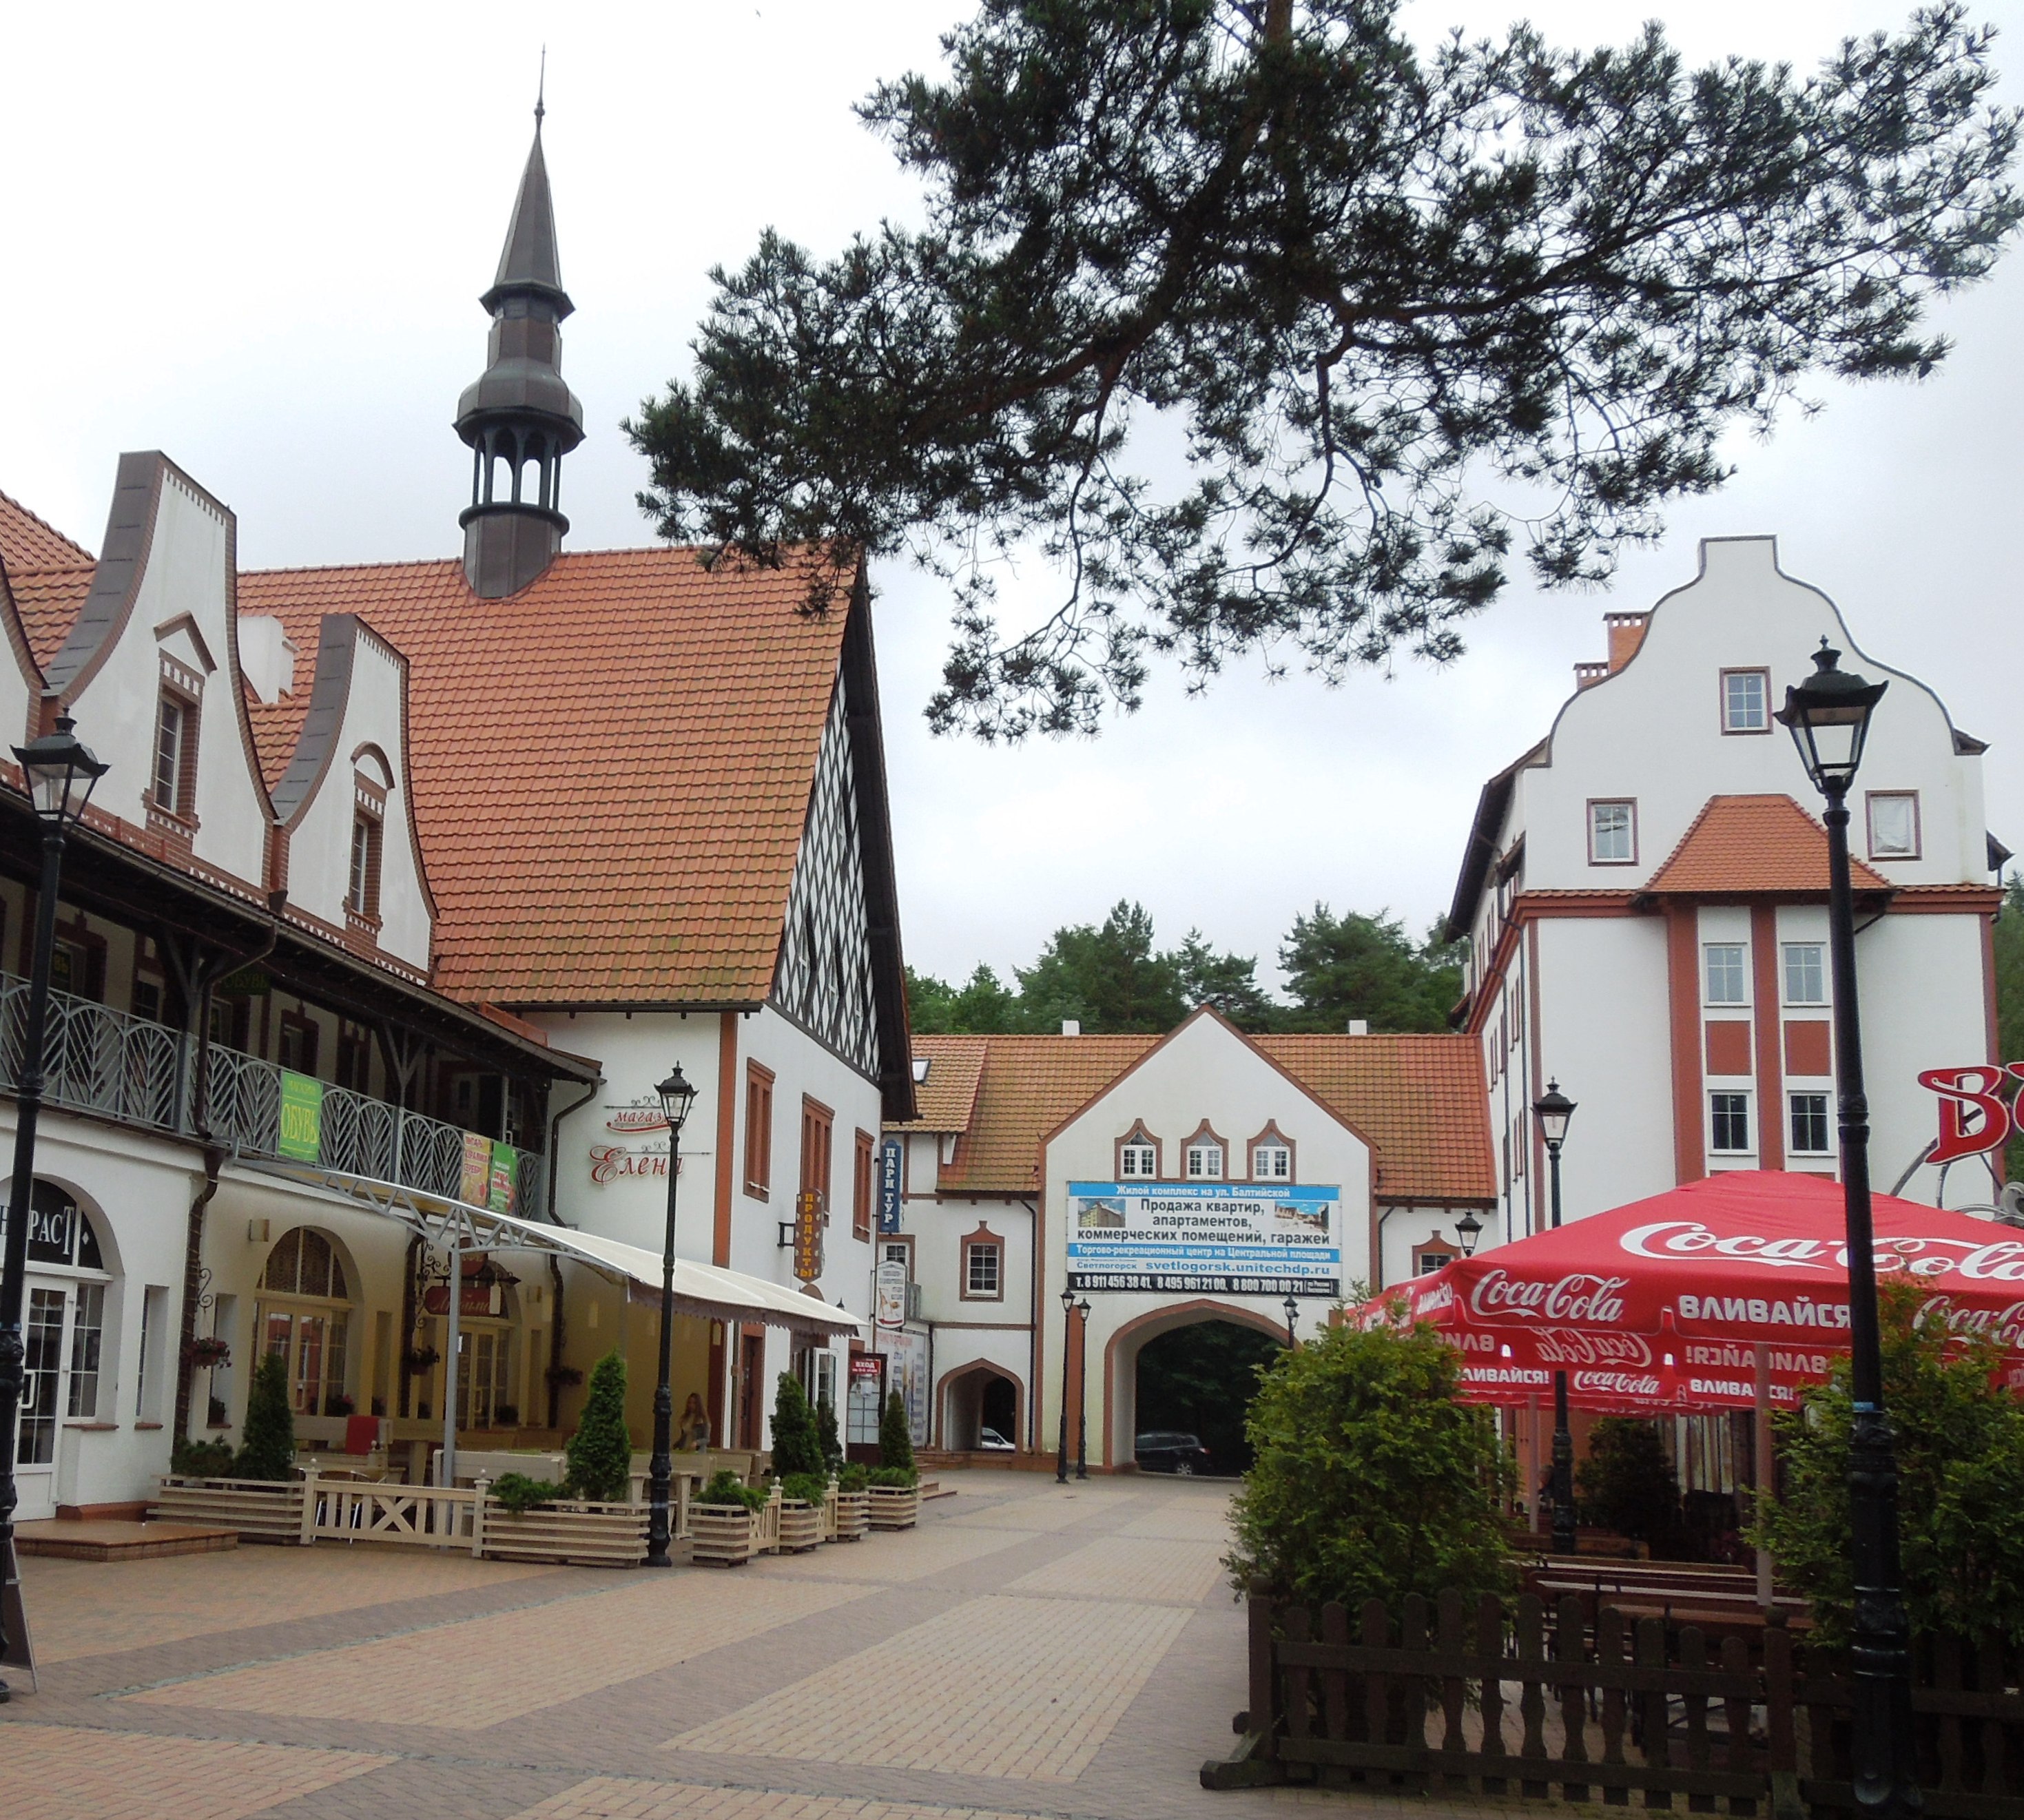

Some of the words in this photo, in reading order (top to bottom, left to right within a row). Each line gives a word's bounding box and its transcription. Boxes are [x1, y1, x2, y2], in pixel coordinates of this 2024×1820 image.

[281, 1102, 318, 1144] ОБУВЬ
[885, 1148, 896, 1189] ПАРИ
[1116, 1185, 1150, 1195] Жилой
[1152, 1187, 1199, 1196] комплекс
[1201, 1188, 1213, 1197] на
[1215, 1189, 1229, 1199] ул.
[1232, 1187, 1290, 1198] Балтийской
[884, 1192, 894, 1224] ТУР
[1141, 1198, 1201, 1214] Продажа
[1206, 1202, 1265, 1215] квартир,
[1153, 1216, 1252, 1230] апартаментов,
[800, 1193, 814, 1277] ПРОДУКТЫ
[1077, 1230, 1177, 1243] коммерческих
[1181, 1230, 1267, 1245] помещений,
[1076, 1244, 1184, 1257] Торгово-рекреационный
[1186, 1248, 1212, 1259] центр
[1215, 1249, 1226, 1257] на
[1228, 1248, 1288, 1259] Центральной
[1290, 1252, 1331, 1261] площади
[1076, 1261, 1137, 1271] Светлогорск
[1146, 1261, 1330, 1276] svetlogorsk.unitechdp.ru
[1084, 1276, 1091, 1288] 8
[1092, 1276, 1106, 1288] 911
[1108, 1276, 1126, 1288] 456
[1126, 1276, 1139, 1288] 38
[1157, 1276, 1164, 1288] 8
[1165, 1276, 1183, 1289] 495
[1184, 1276, 1200, 1290] 961
[1202, 1278, 1212, 1290] 21
[1233, 1279, 1239, 1291] 8
[1241, 1279, 1259, 1292] 800
[1260, 1279, 1277, 1293] 700
[1279, 1280, 1291, 1292] 00
[1292, 1281, 1303, 1292] 21
[1471, 1269, 1631, 1322] Coca-Cola
[1690, 1378, 1794, 1401] ВЛИВАСЯ!
